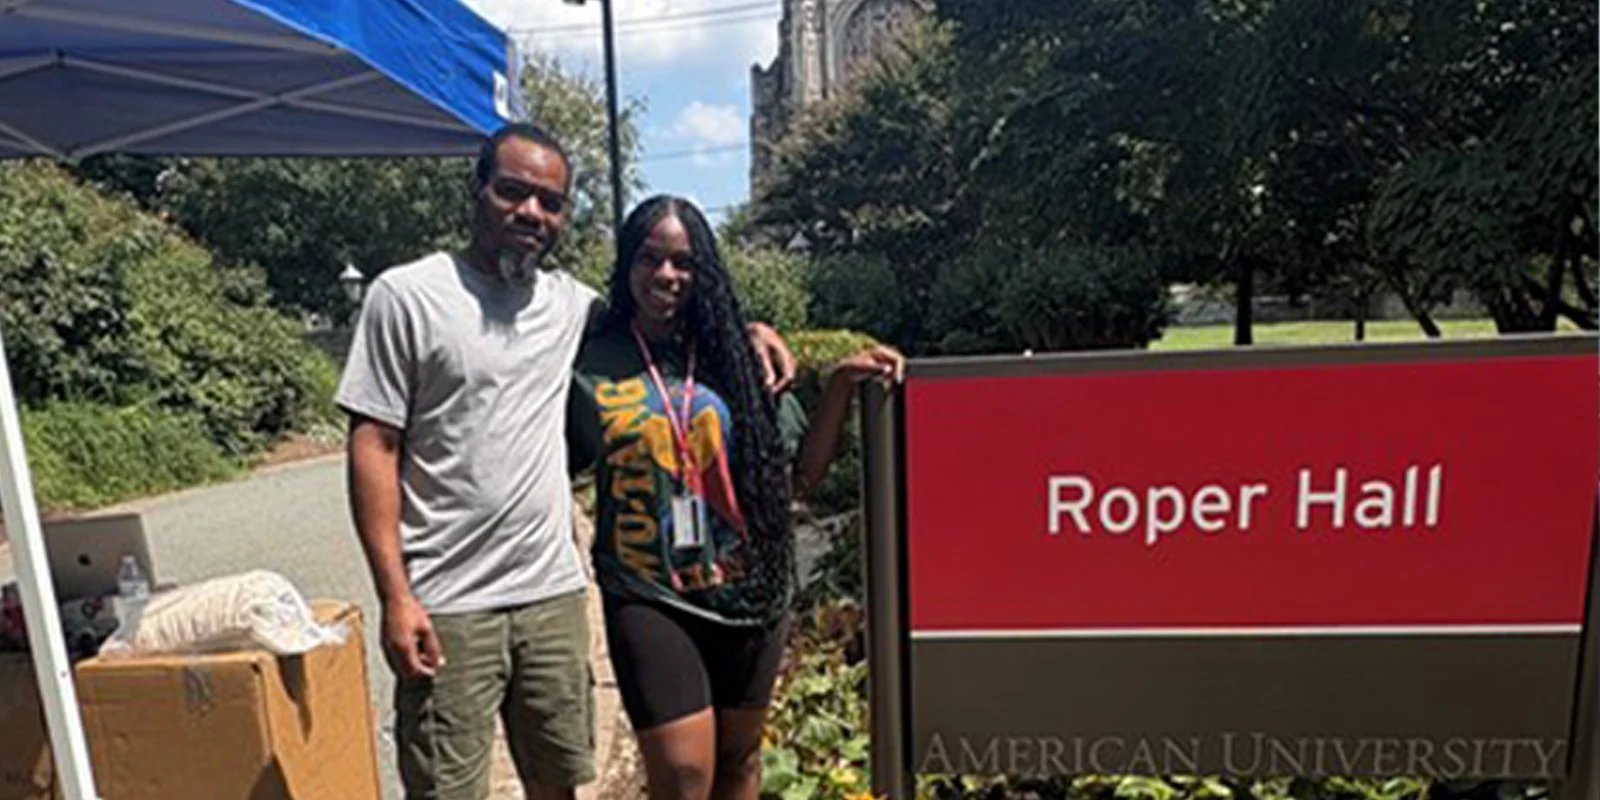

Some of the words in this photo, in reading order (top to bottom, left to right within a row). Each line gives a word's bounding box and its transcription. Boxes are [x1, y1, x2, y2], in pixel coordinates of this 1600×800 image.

[1046, 476, 1268, 544] Roper
[1296, 465, 1442, 529] Hall
[921, 732, 1201, 776] AMERICAN
[1221, 731, 1566, 779] UNIVERSITY
